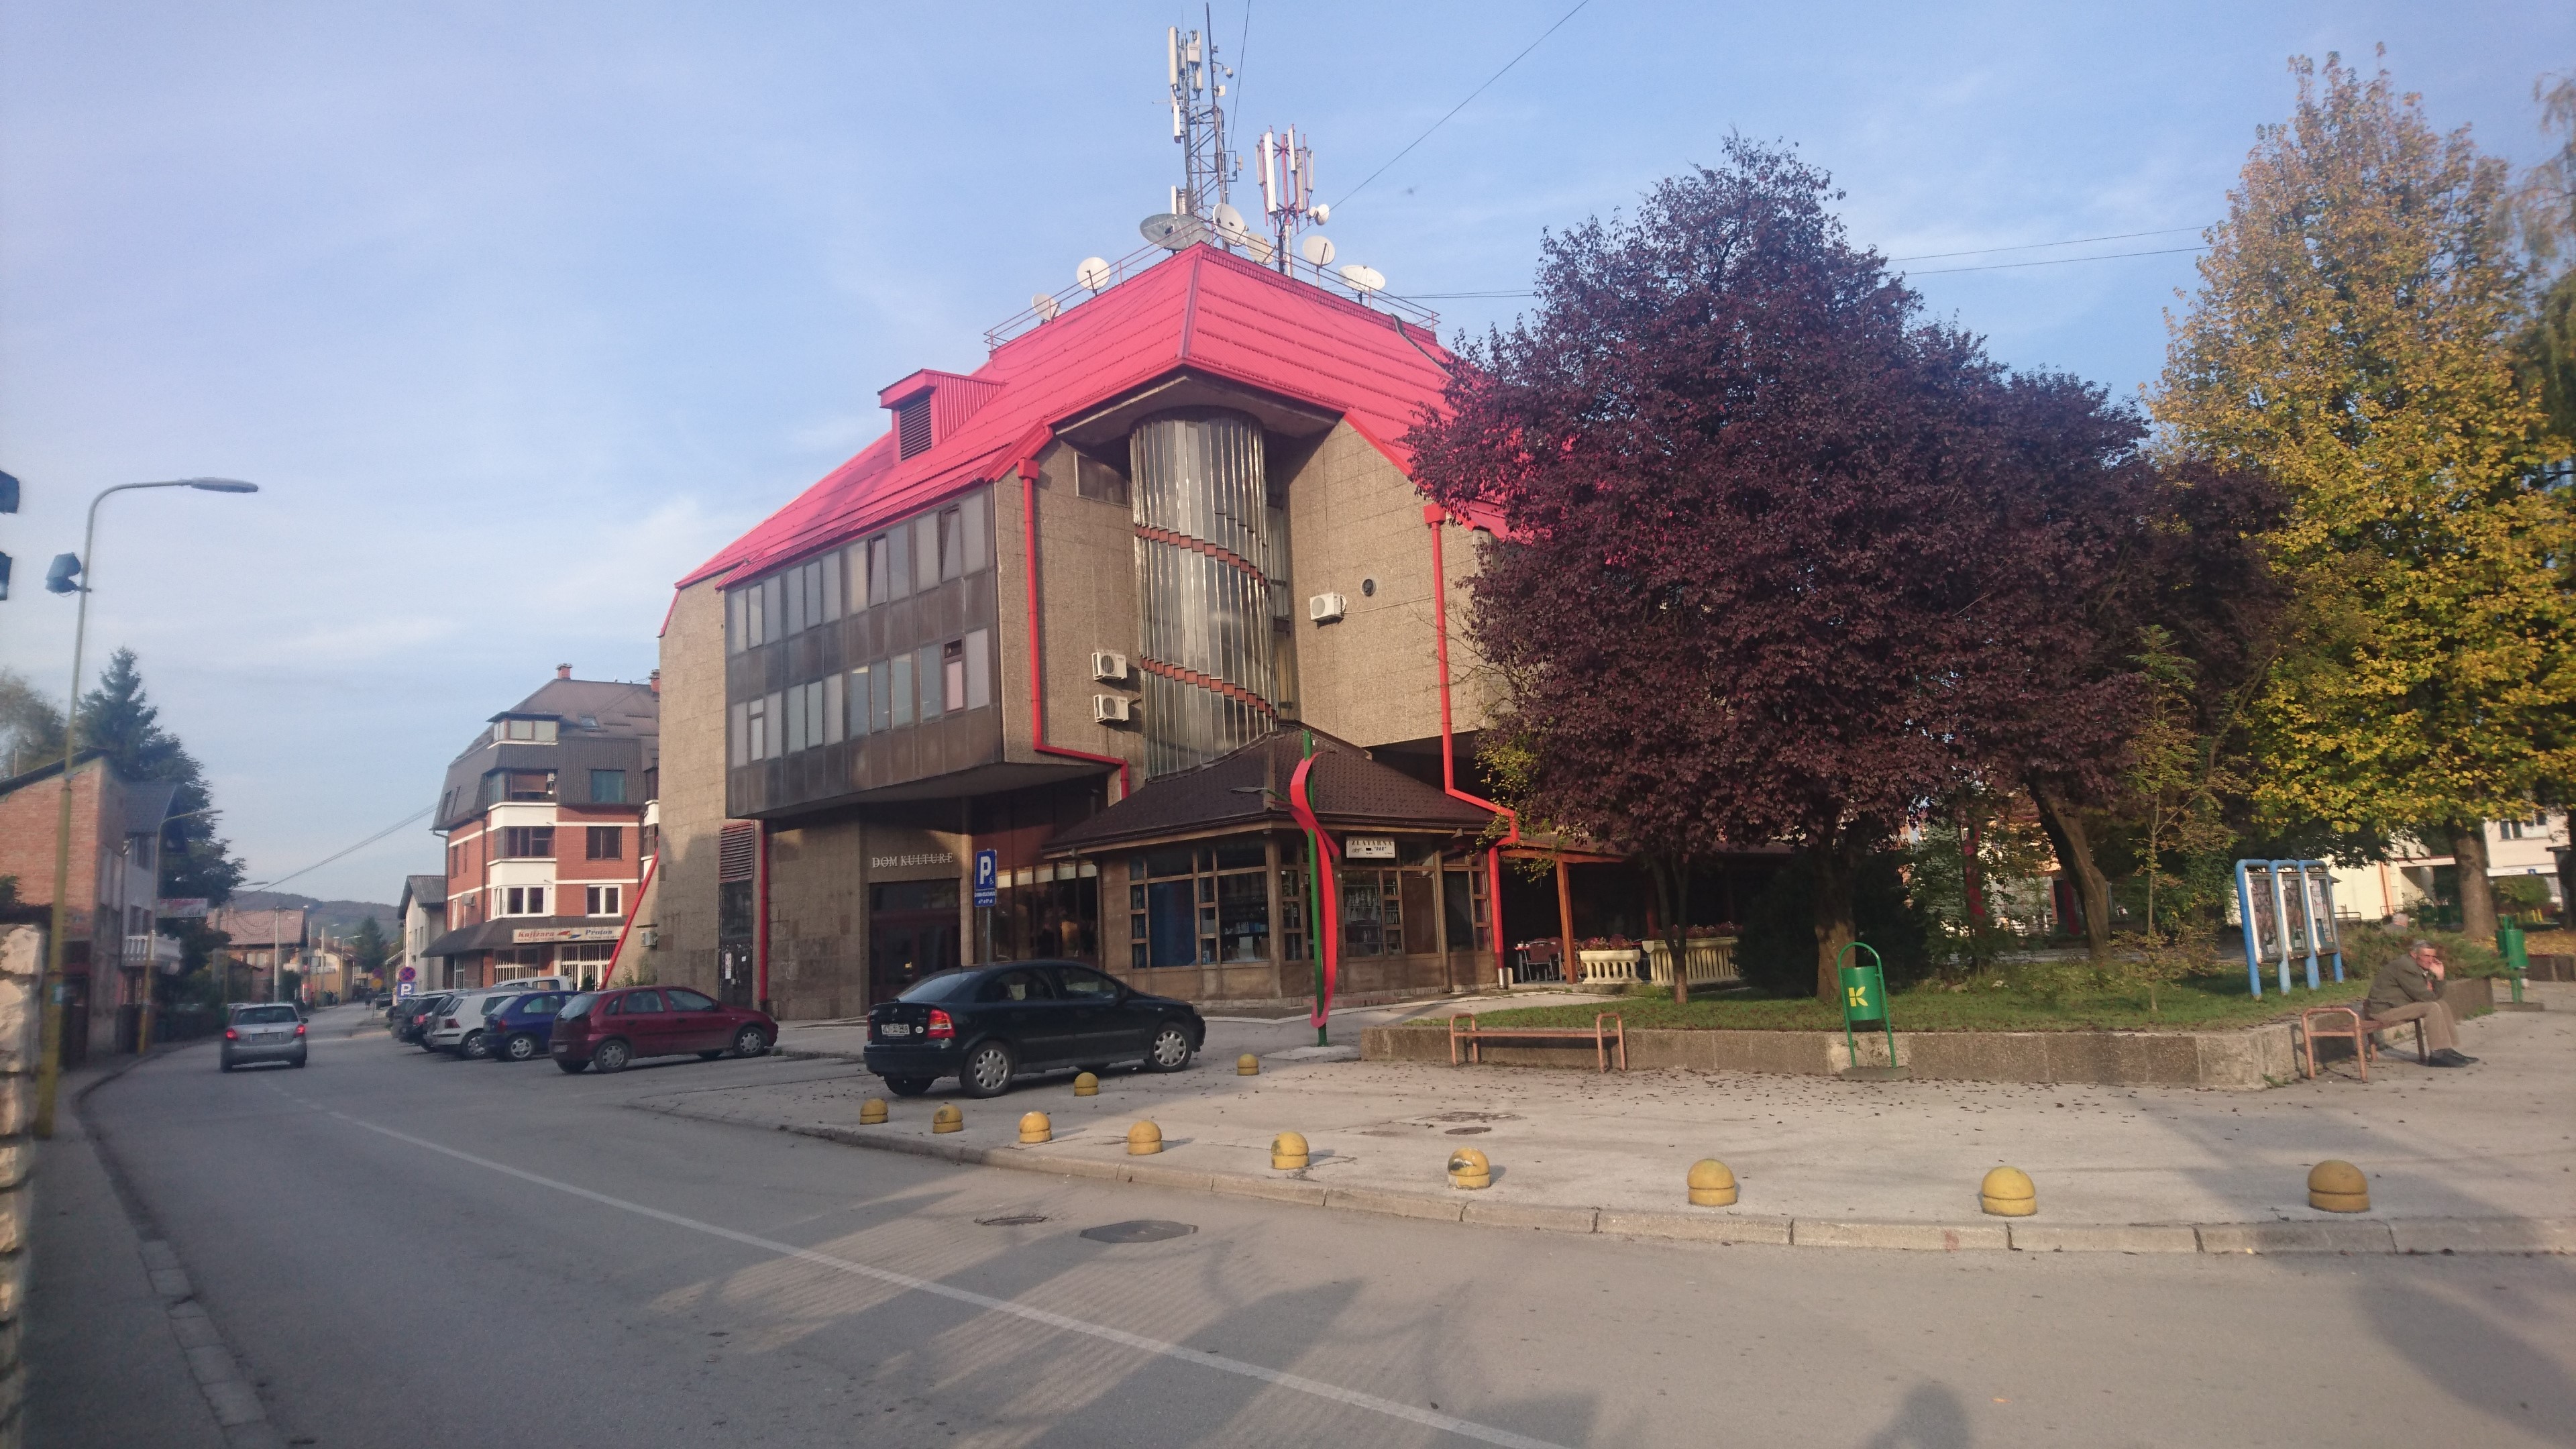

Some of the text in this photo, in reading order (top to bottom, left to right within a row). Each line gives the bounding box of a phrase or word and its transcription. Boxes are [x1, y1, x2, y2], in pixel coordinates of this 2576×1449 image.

[872, 853, 953, 868] DOM KULTURE
[980, 856, 991, 885] P
[400, 983, 412, 996] P
